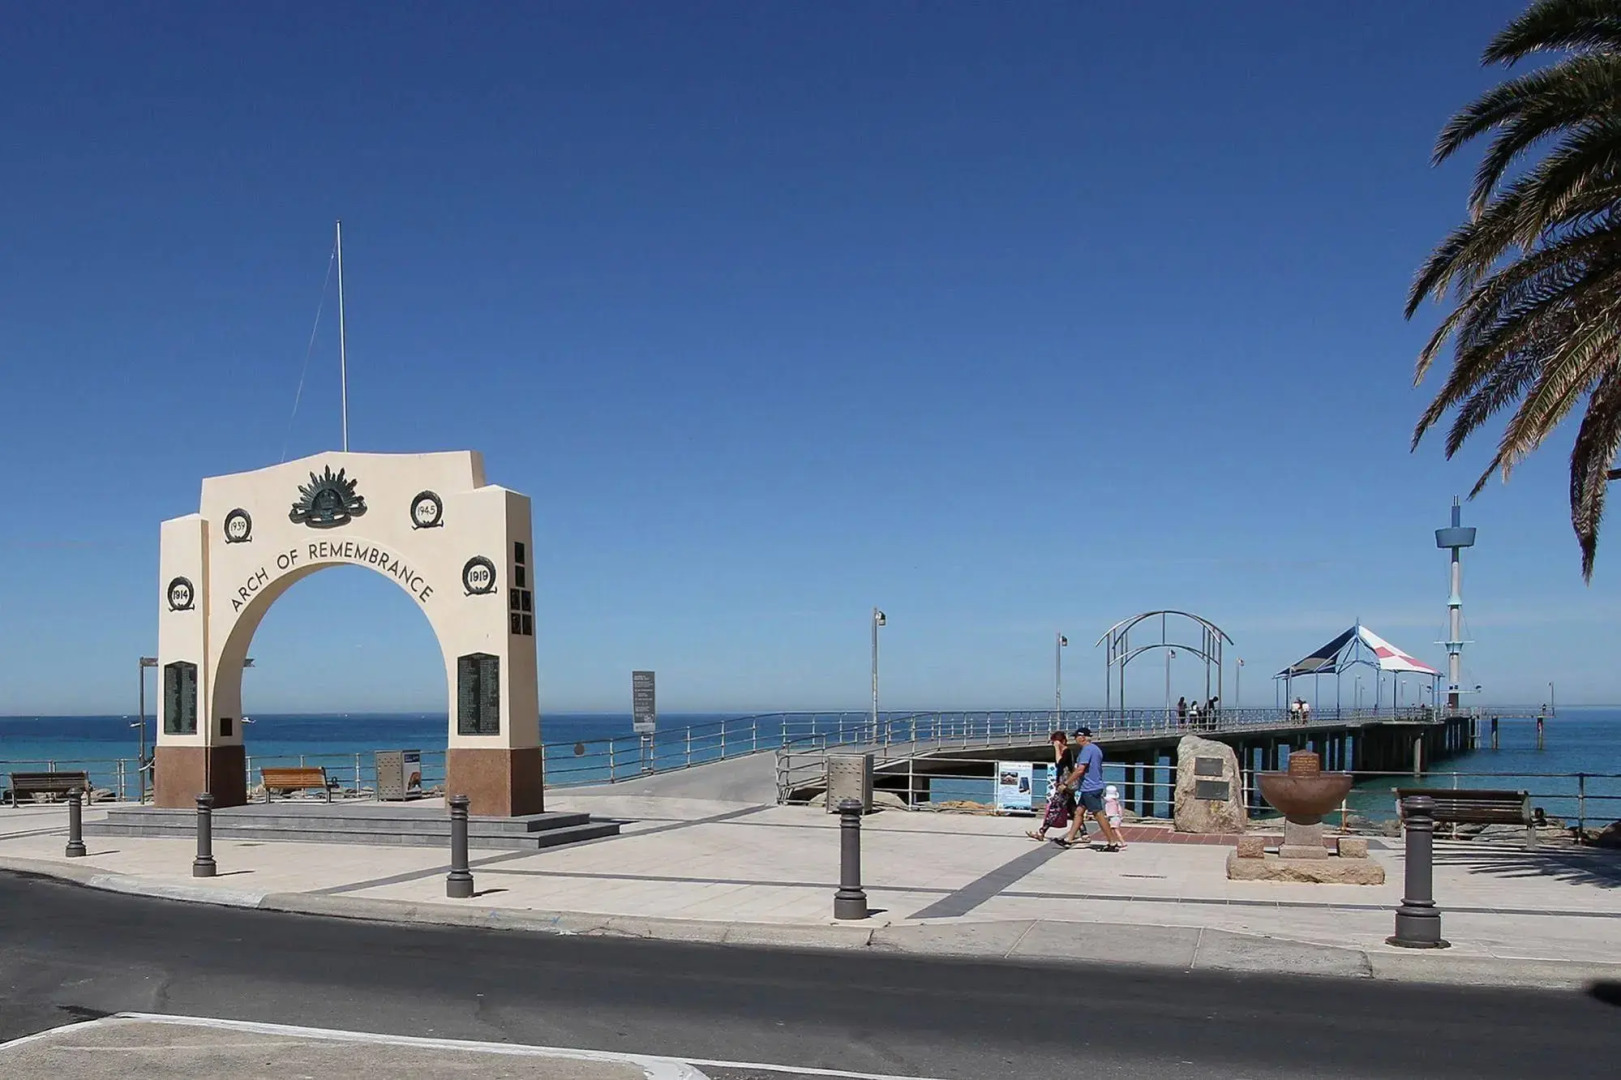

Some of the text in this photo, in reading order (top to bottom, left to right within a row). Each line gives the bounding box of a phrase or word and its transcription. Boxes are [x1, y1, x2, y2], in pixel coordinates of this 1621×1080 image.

[417, 505, 436, 516] 1945
[230, 521, 246, 531] 1939
[231, 542, 434, 612] ARCH OF REMEMBRANCE
[469, 570, 489, 582] 1919
[173, 589, 189, 600] 1914
